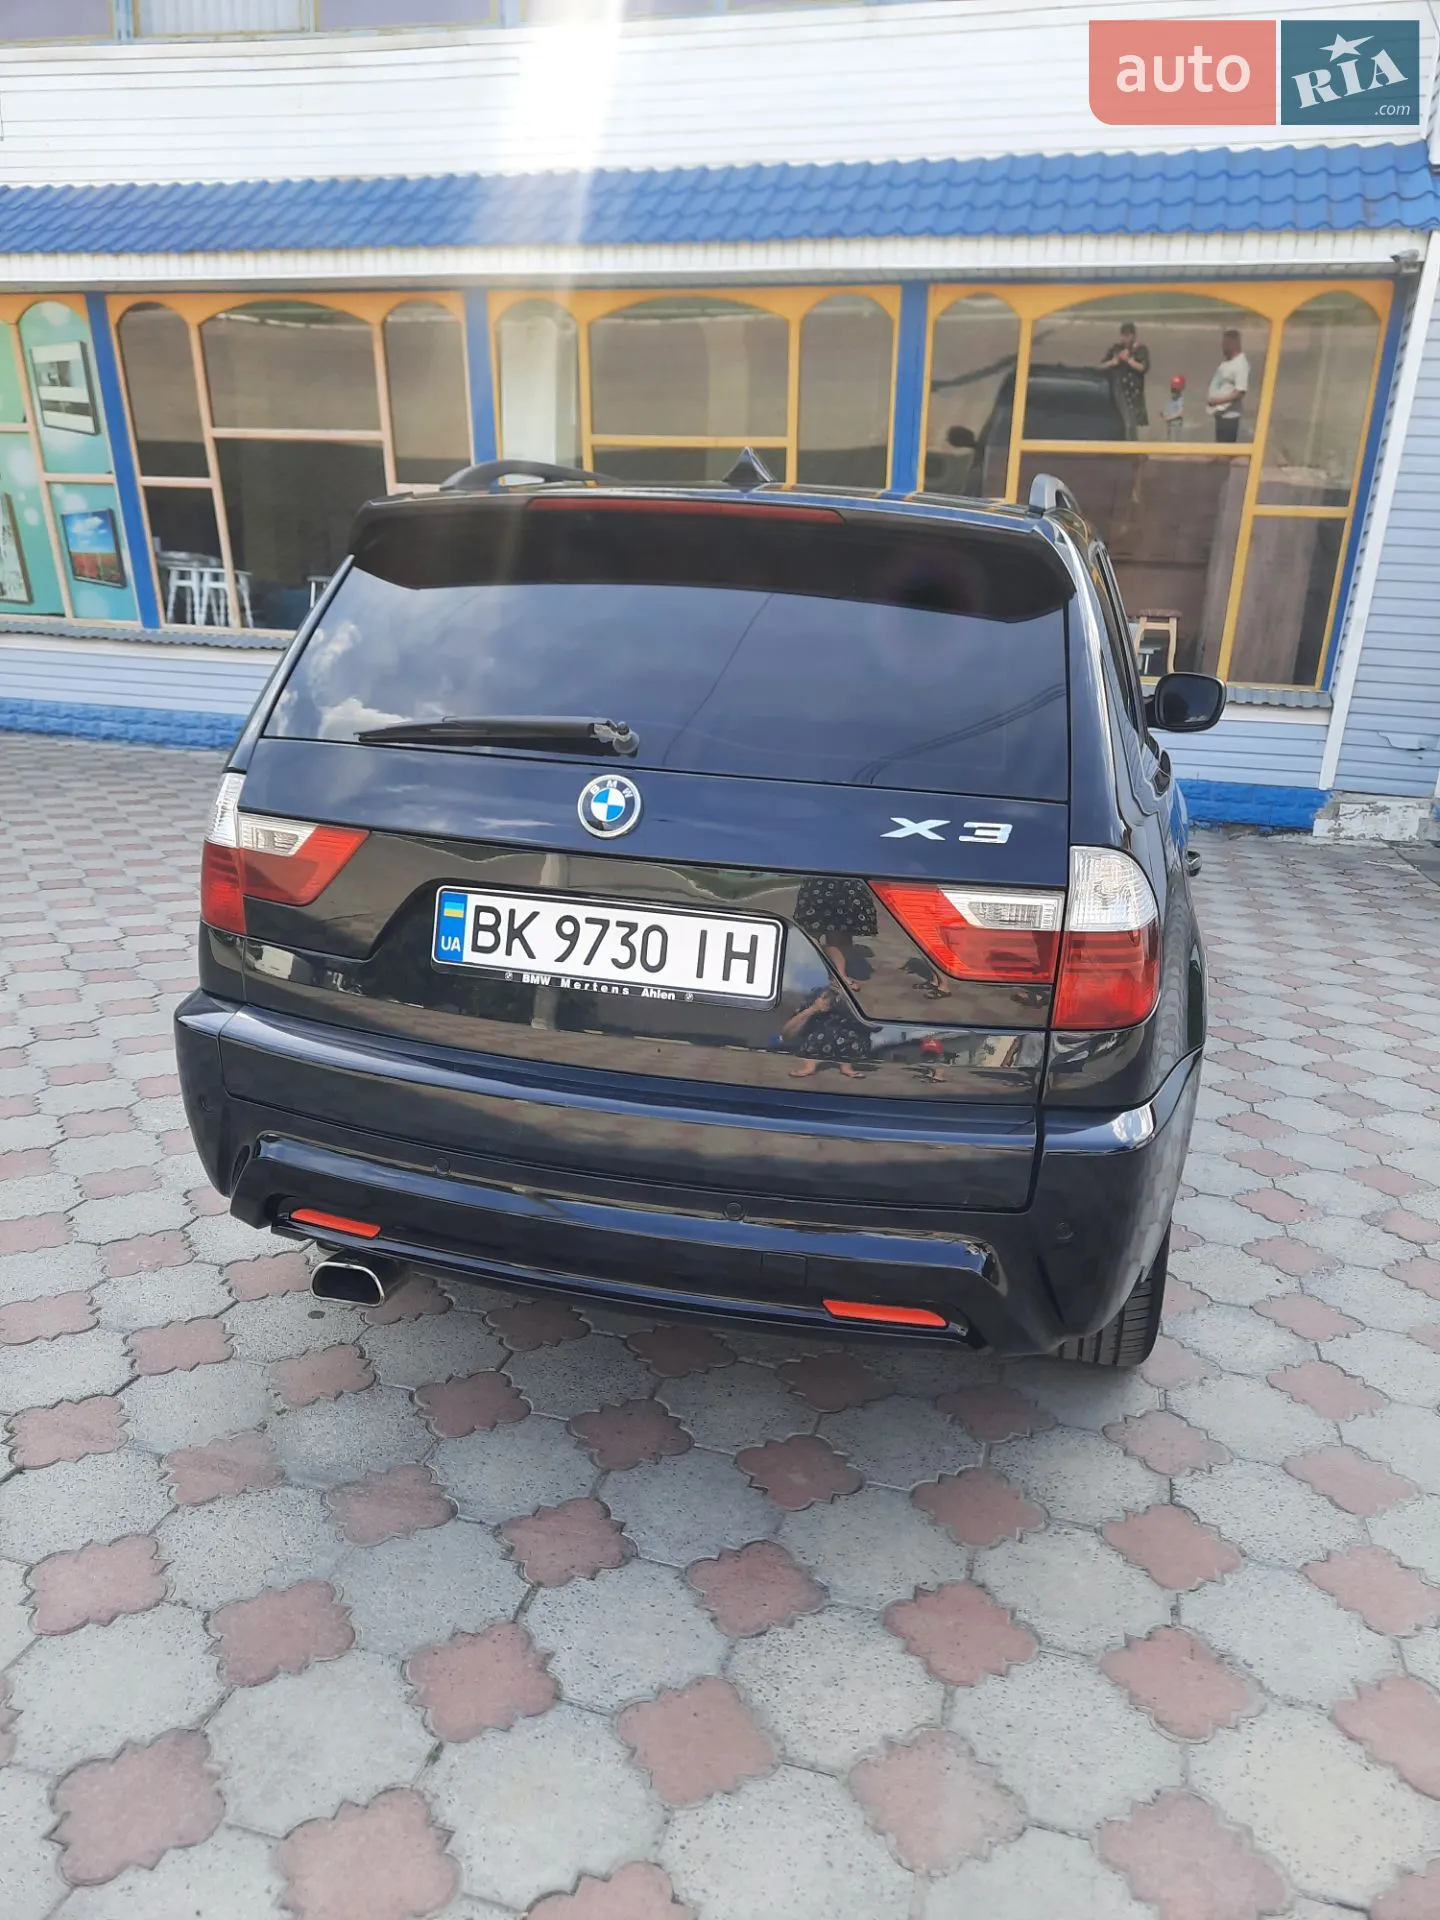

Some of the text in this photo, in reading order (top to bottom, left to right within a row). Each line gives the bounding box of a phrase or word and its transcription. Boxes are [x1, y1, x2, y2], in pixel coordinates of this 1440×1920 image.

[590, 780, 634, 798] BMW
[441, 936, 462, 952] UA
[470, 905, 759, 985] BK 9730 IH
[522, 973, 677, 1001] BMW Mertens Ahlen
